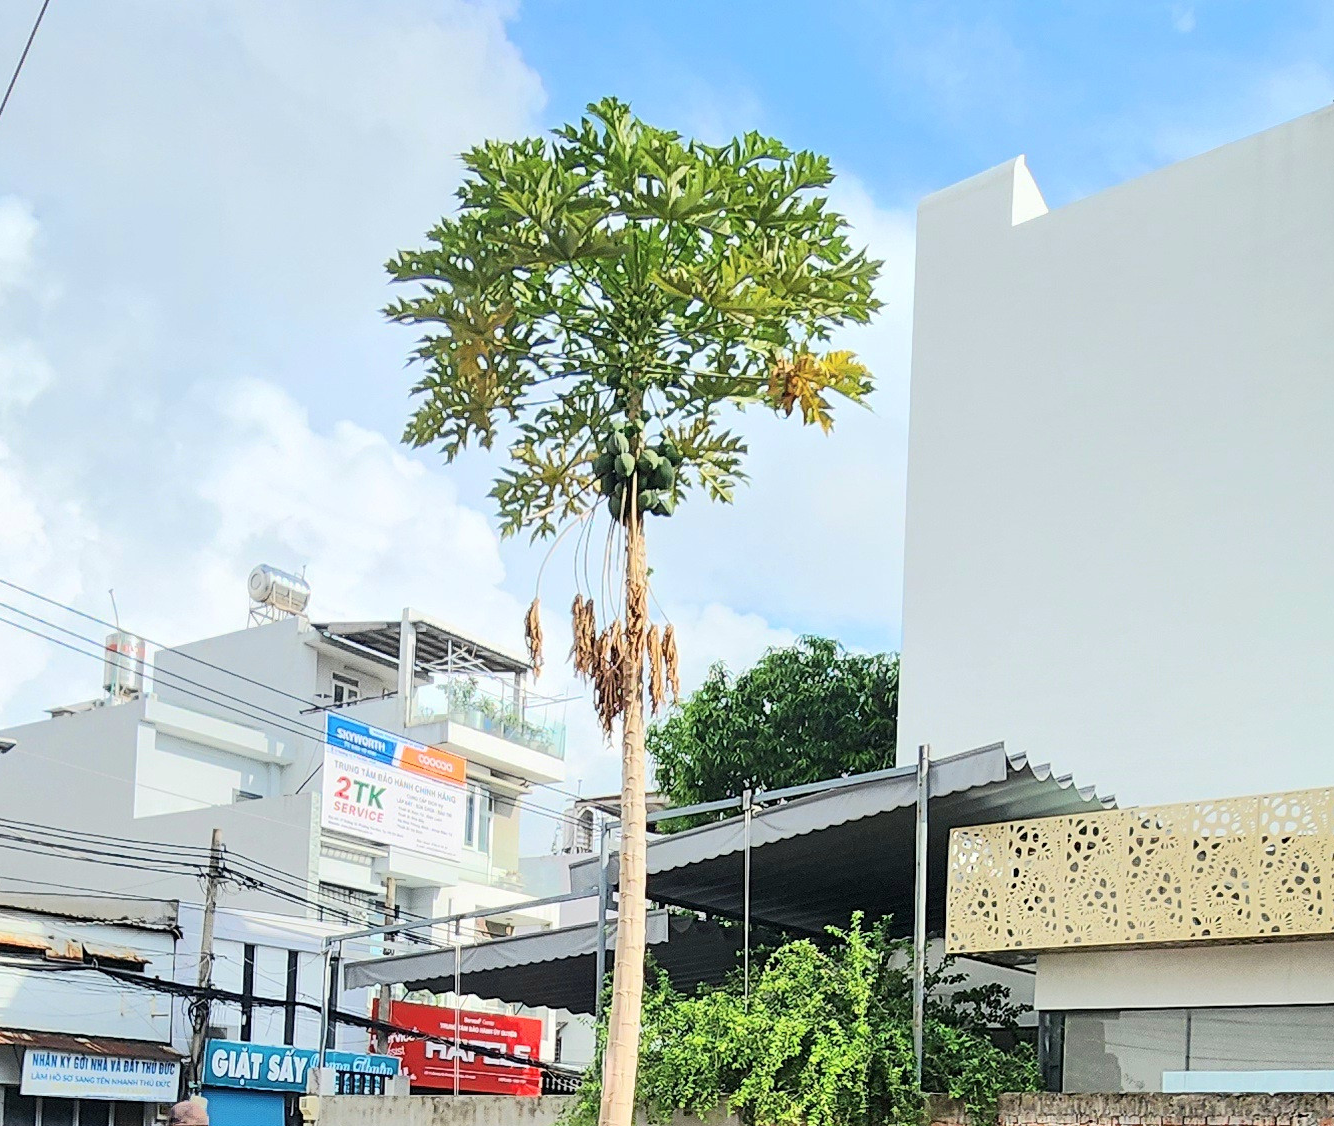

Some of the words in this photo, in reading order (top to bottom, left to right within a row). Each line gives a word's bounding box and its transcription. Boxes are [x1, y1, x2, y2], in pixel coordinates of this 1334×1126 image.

[336, 727, 386, 753] SKYWORTH
[334, 759, 360, 775] TRUNG
[361, 765, 377, 780] TÂM
[378, 769, 393, 785] BẢO
[394, 776, 414, 791] HÀNH
[334, 775, 387, 810] 2TK
[333, 801, 385, 823] SERVICE
[32, 1052, 57, 1071] NHẬN
[60, 1052, 72, 1069] KÝ
[90, 1056, 108, 1072] NHÀ
[110, 1056, 121, 1073] VÀ
[123, 1057, 139, 1074] ĐẤT
[141, 1057, 156, 1075] THỦ
[158, 1058, 176, 1076] ĐỨC
[211, 1045, 263, 1086] GIẶT
[267, 1048, 308, 1084] SẤY
[31, 1071, 48, 1081] LÀM
[74, 1075, 95, 1084] SANG
